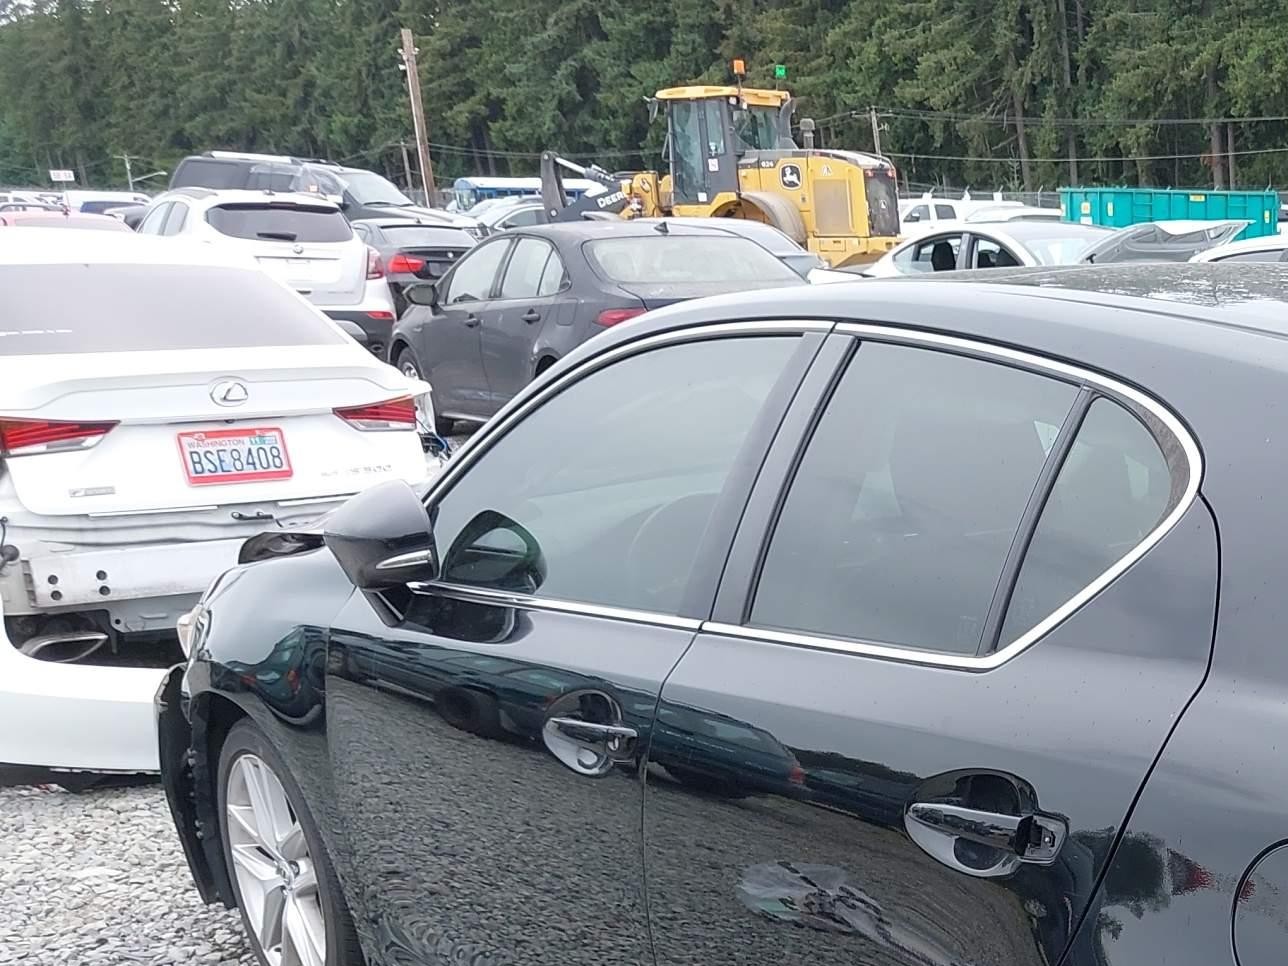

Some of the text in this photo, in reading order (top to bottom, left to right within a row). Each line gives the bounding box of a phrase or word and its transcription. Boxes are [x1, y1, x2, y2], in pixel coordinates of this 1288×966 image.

[597, 191, 625, 208] DEER
[187, 439, 245, 449] WASHINGTON
[189, 446, 284, 475] BSE8408
